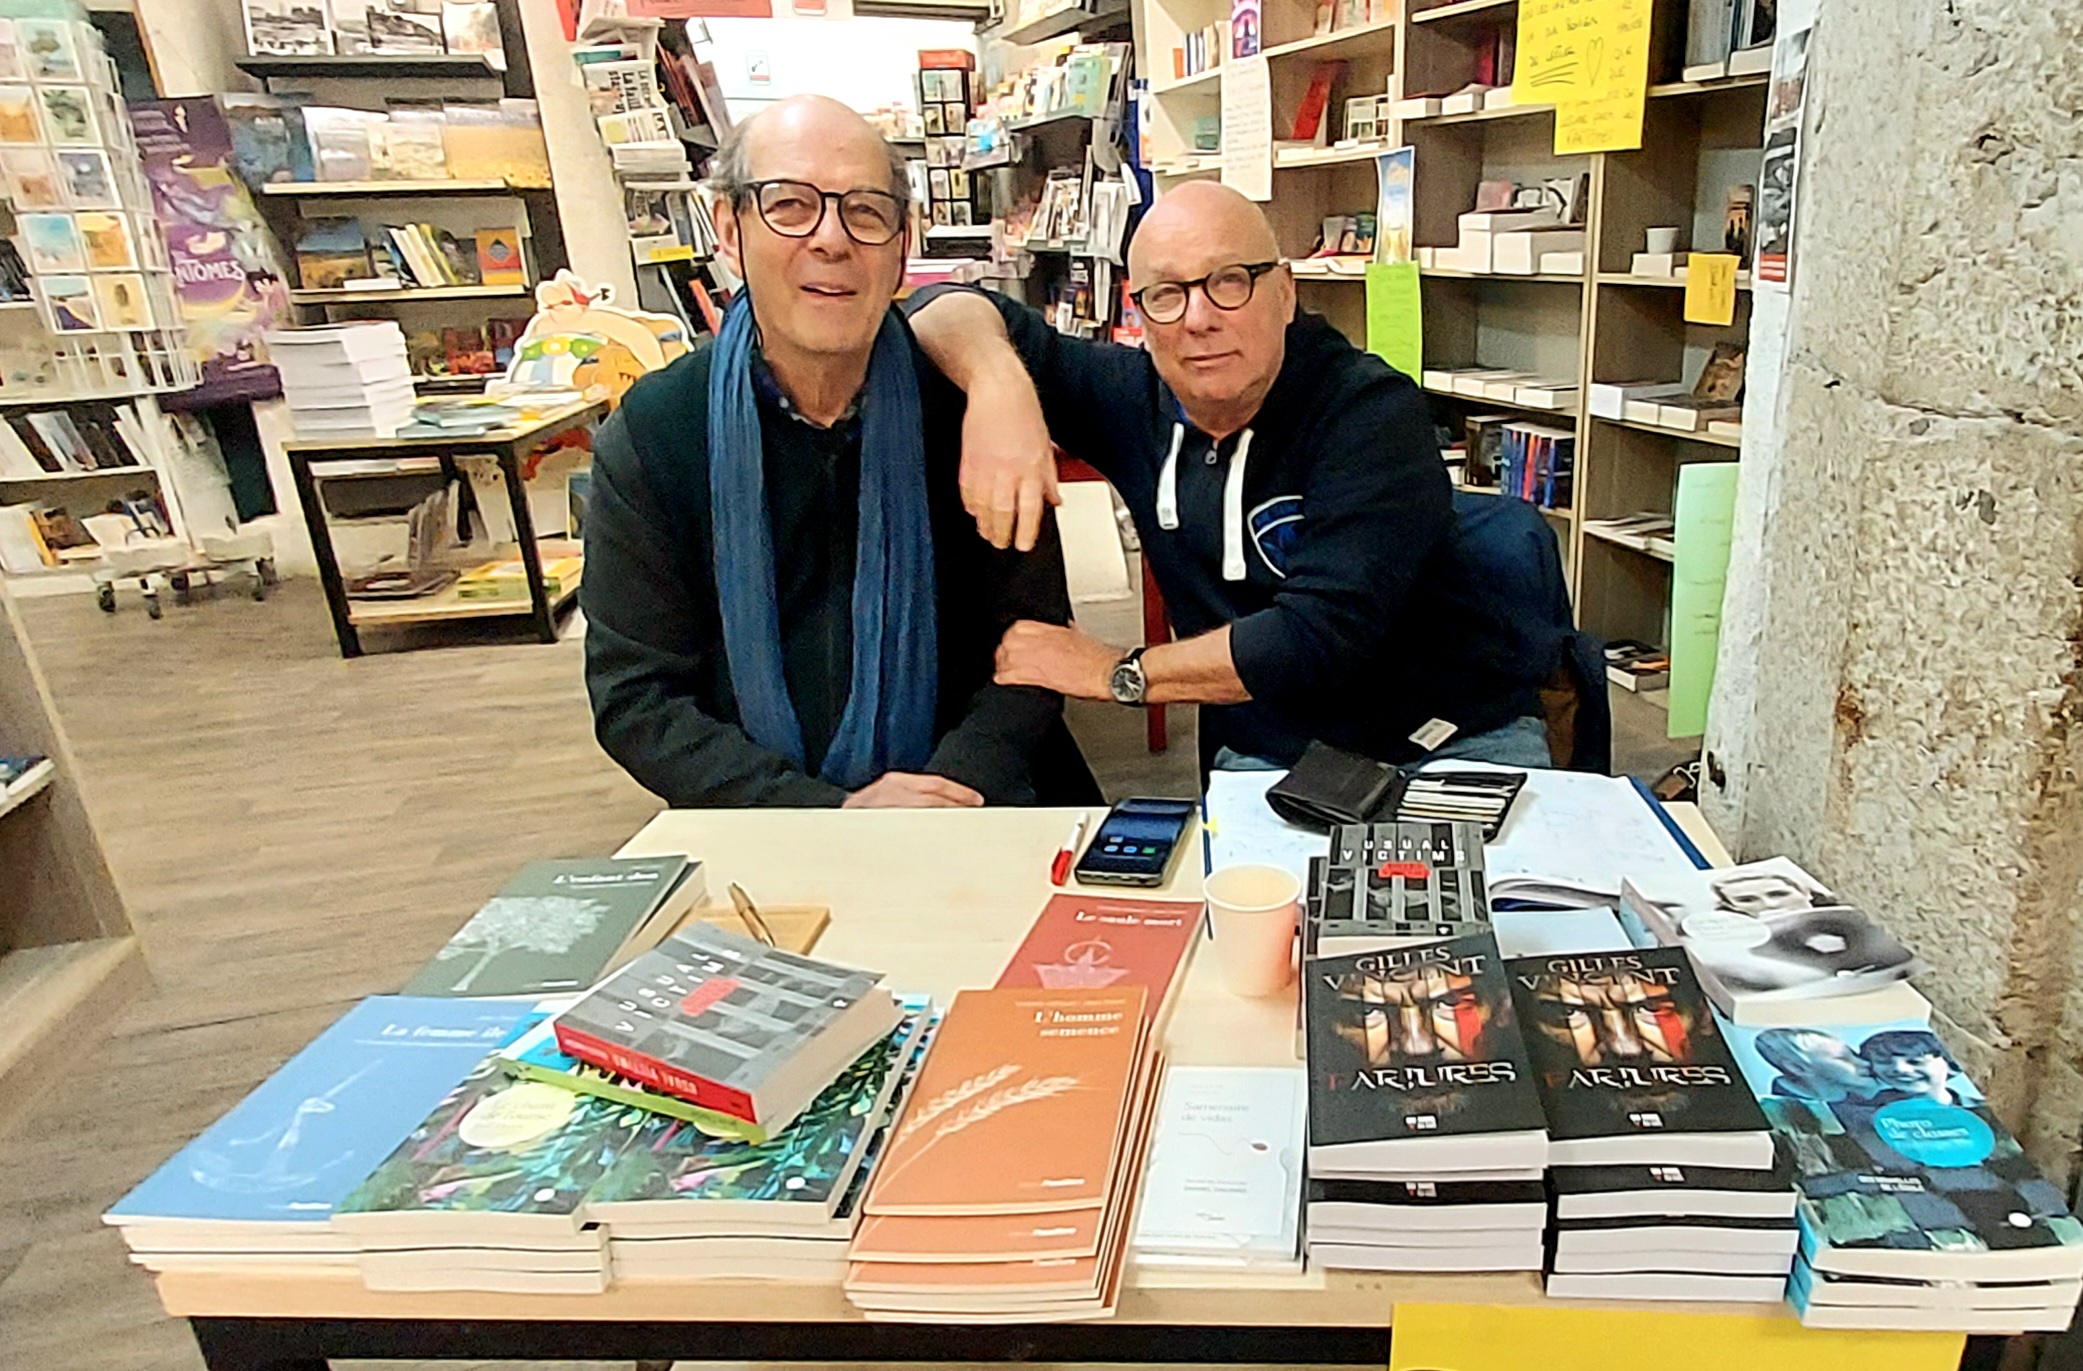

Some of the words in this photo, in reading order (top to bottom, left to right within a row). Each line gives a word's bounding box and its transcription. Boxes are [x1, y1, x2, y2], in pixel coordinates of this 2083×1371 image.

[1363, 839, 1450, 850] USUAL
[1342, 850, 1466, 862] VICTIMS
[1355, 946, 1452, 971] GILLES
[1548, 955, 1643, 974] GILLES
[618, 952, 710, 1012] USUAL
[1034, 1010, 1123, 1024] L'homme
[1039, 1026, 1120, 1038] semence
